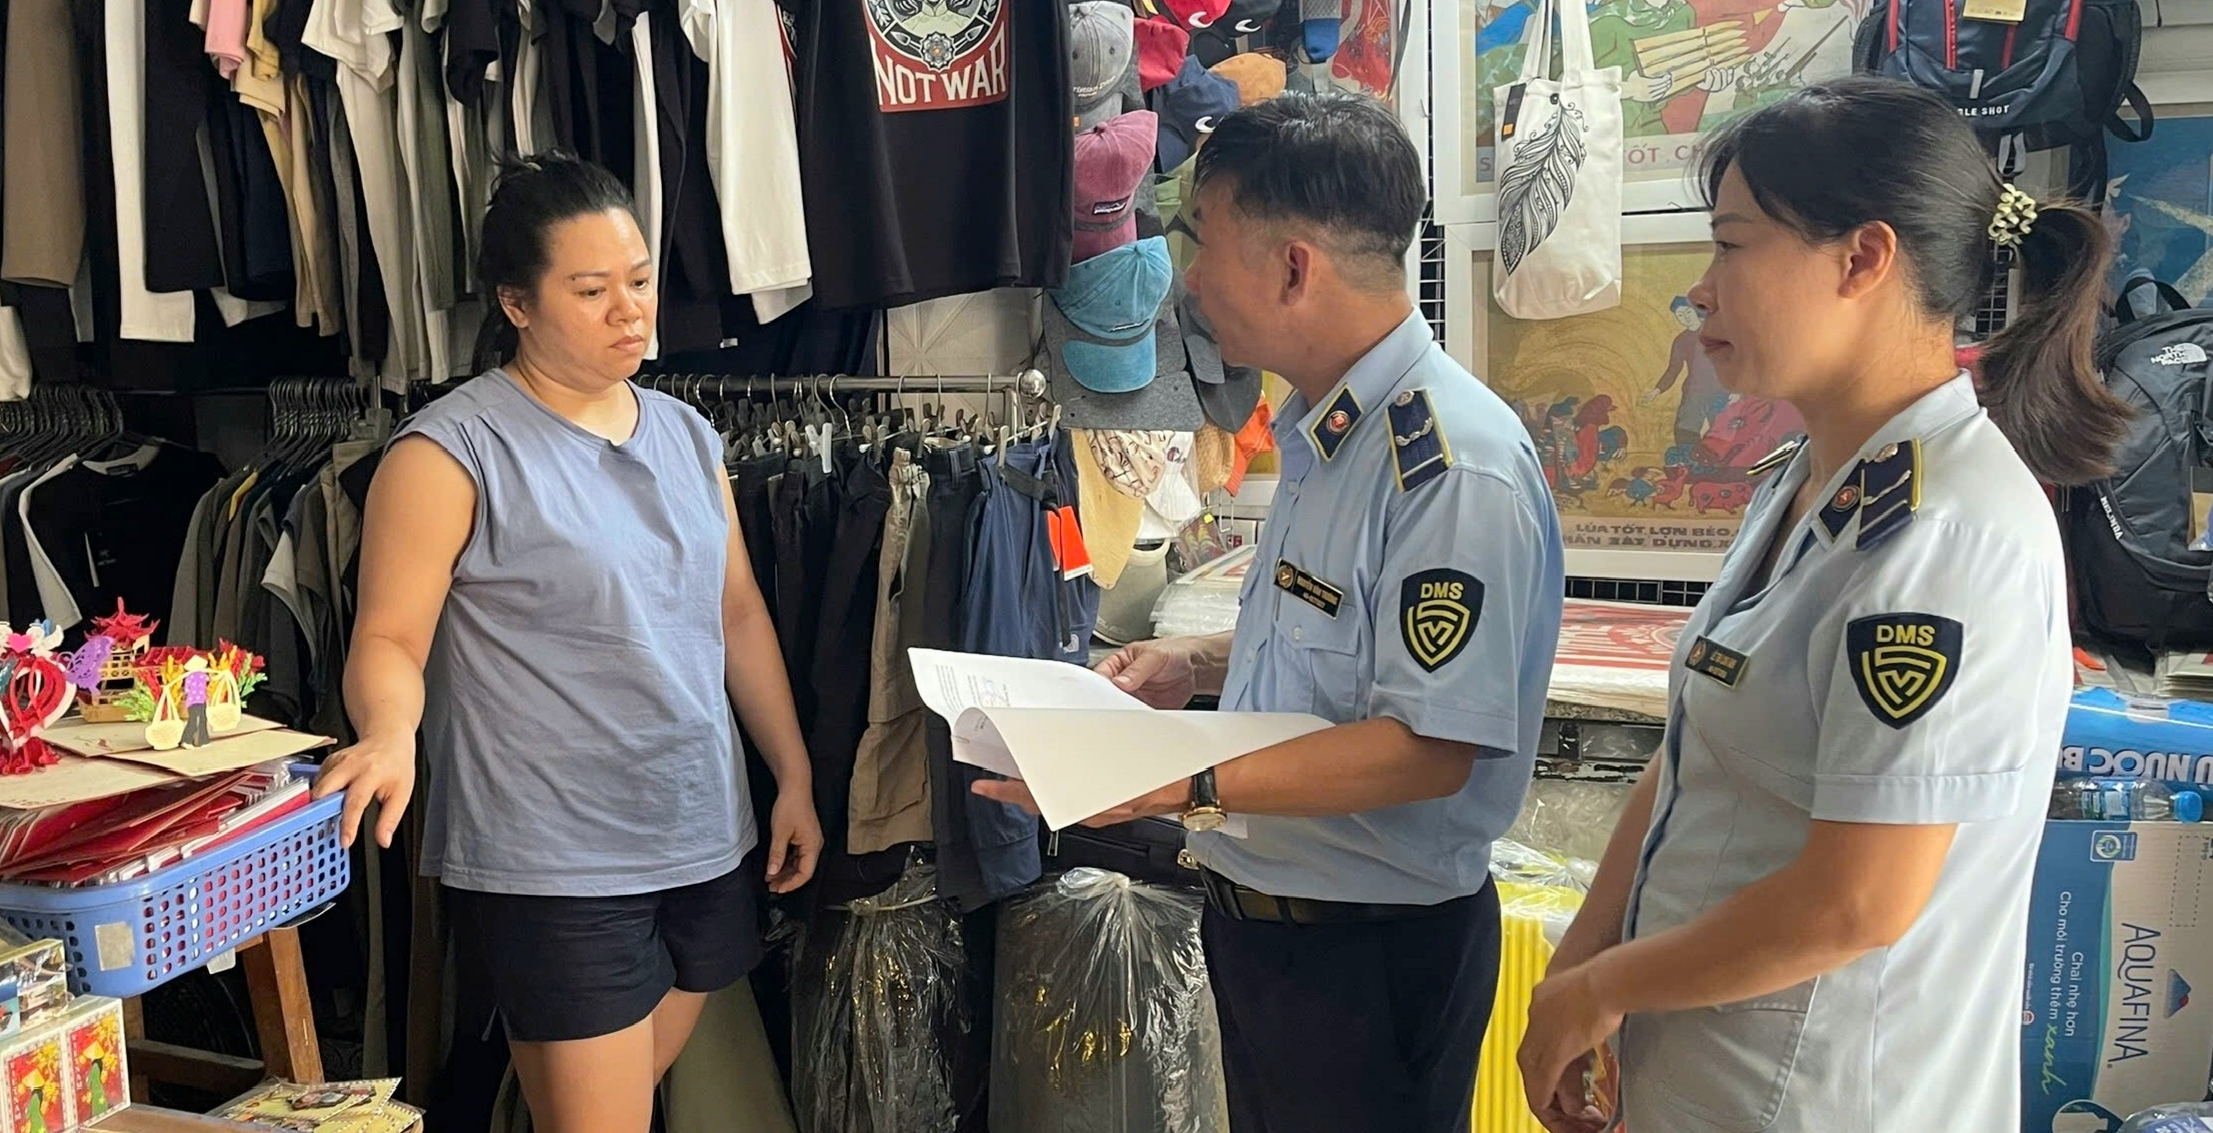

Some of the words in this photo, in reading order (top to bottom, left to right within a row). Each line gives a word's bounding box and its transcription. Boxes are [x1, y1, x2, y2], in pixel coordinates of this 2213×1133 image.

[869, 32, 936, 106] NOT
[940, 21, 1007, 101] WAR
[1981, 105, 2010, 116] SHOT
[1576, 522, 1609, 533] LÚA
[1420, 582, 1464, 600] DMS
[1876, 624, 1935, 646] DMS
[2059, 890, 2072, 917] Cho
[2055, 918, 2067, 941] môi
[2071, 951, 2084, 982] Chai
[2049, 986, 2061, 1020] thêm
[2065, 984, 2081, 1010] nhẹ
[2108, 922, 2162, 1064] AQUAFINA
[2064, 1011, 2080, 1037] hơn
[2041, 1021, 2067, 1095] xanh
